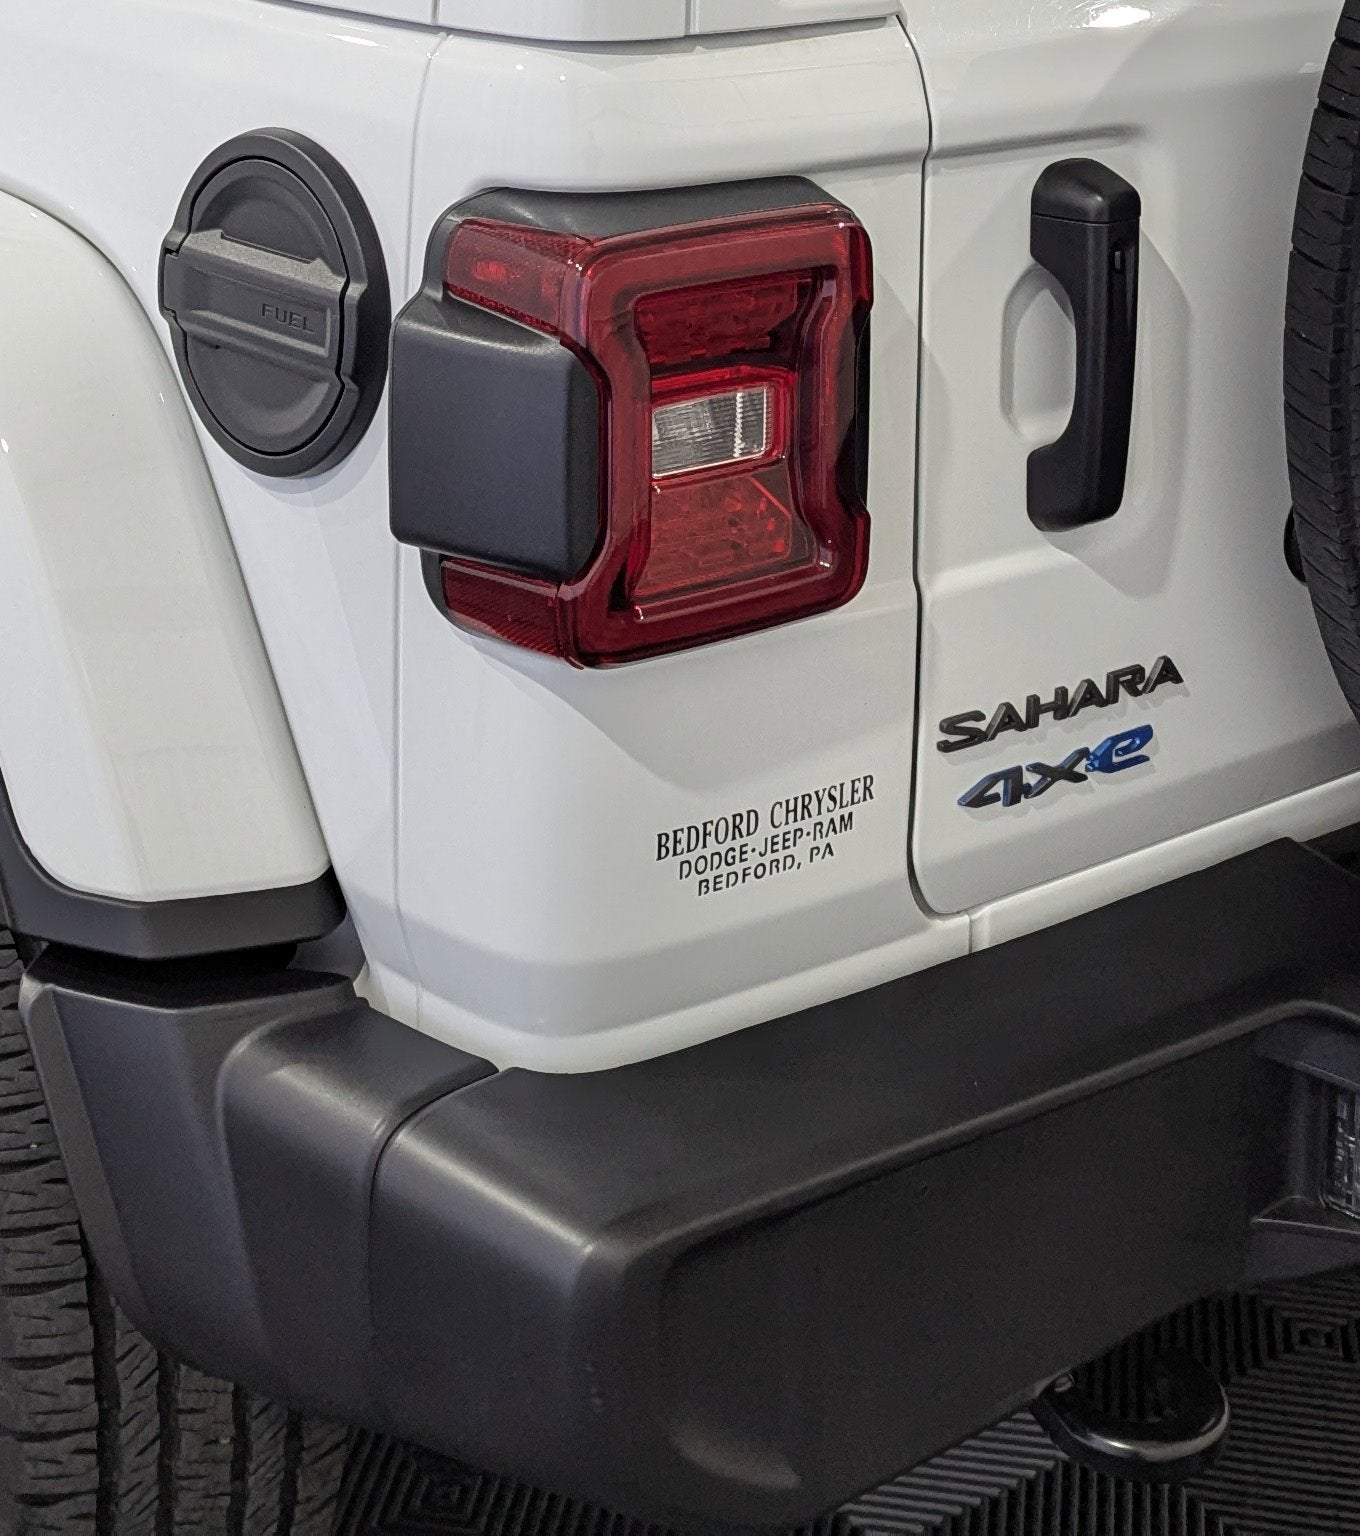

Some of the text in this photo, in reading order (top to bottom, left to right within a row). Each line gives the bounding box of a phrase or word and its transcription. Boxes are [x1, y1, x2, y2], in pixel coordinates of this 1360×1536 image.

[261, 302, 315, 334] FUEL
[937, 655, 1185, 753] SAHARA
[656, 774, 876, 862] BEDFORD CHRYSLER
[698, 842, 835, 897] BEDFORD, PA
